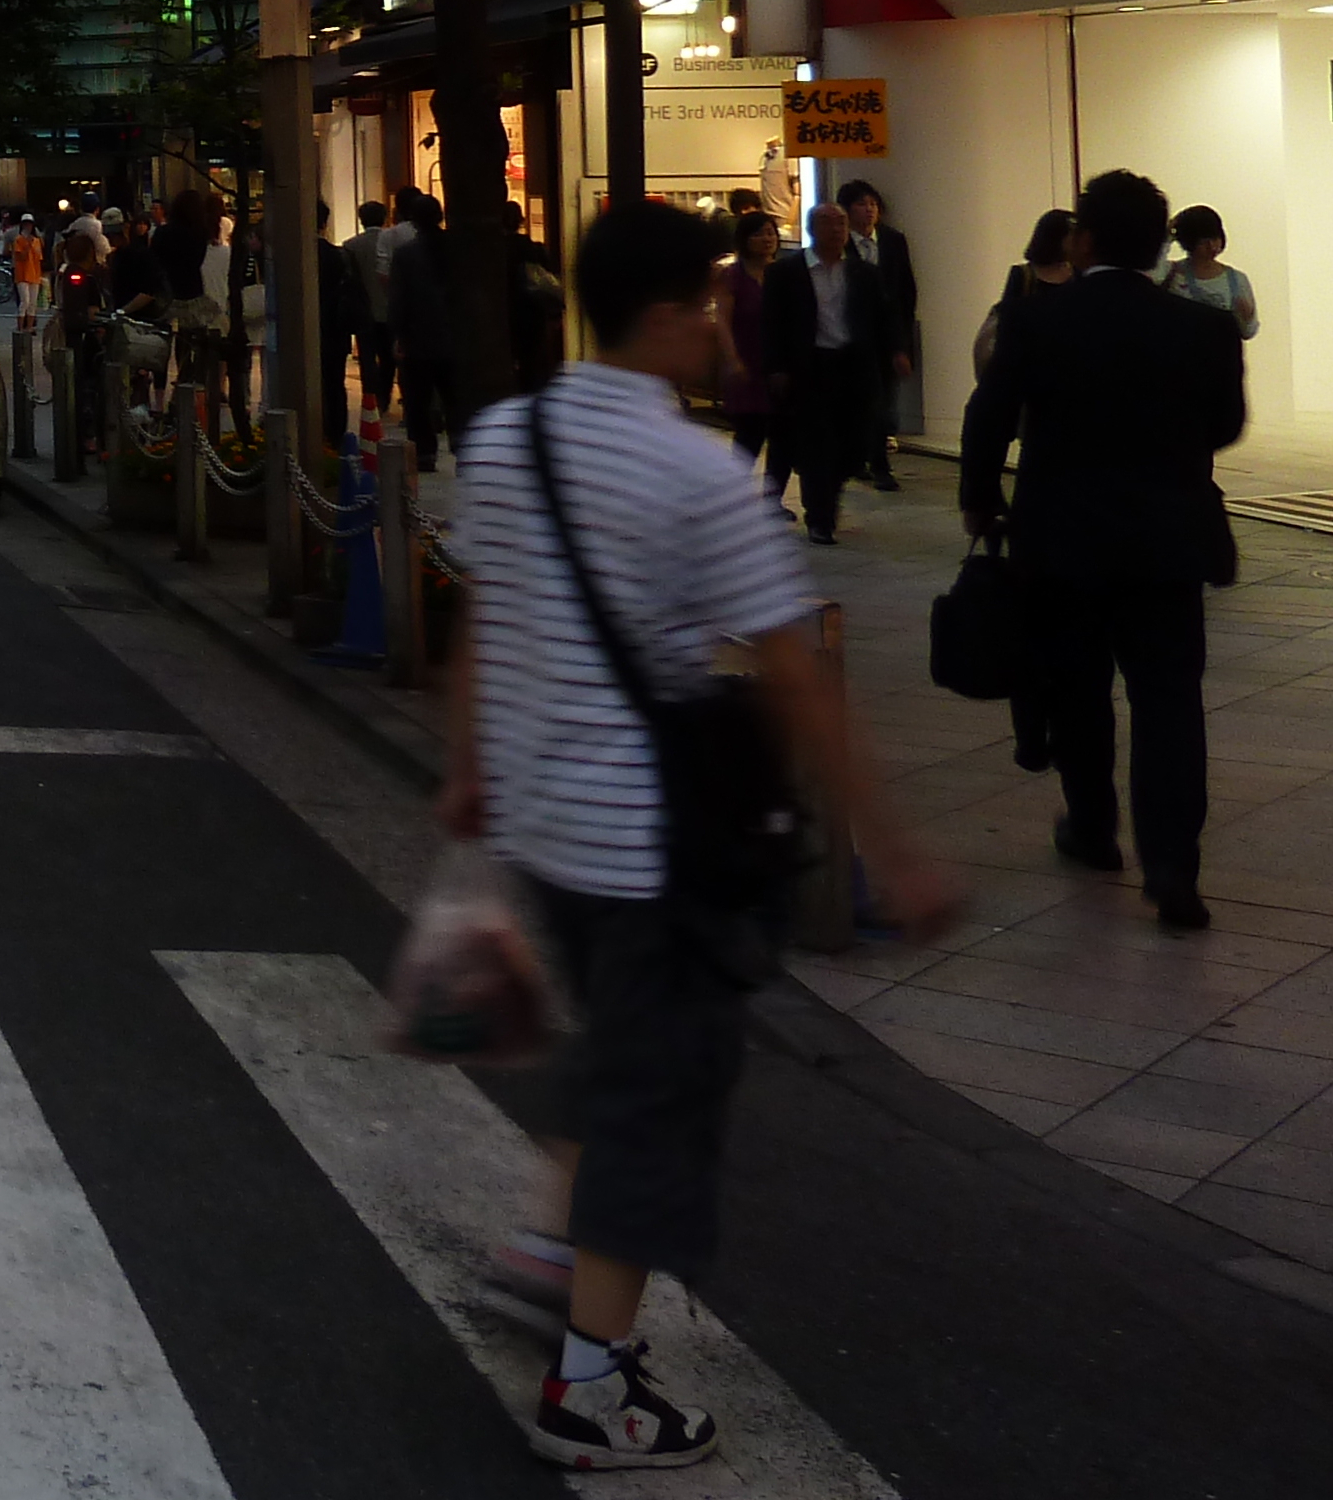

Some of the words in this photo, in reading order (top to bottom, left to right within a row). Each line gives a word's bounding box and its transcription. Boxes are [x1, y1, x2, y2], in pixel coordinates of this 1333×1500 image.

[673, 58, 745, 72] Business
[643, 104, 671, 120] THE
[677, 104, 704, 120] 3rd
[711, 103, 782, 120] WARDRO
